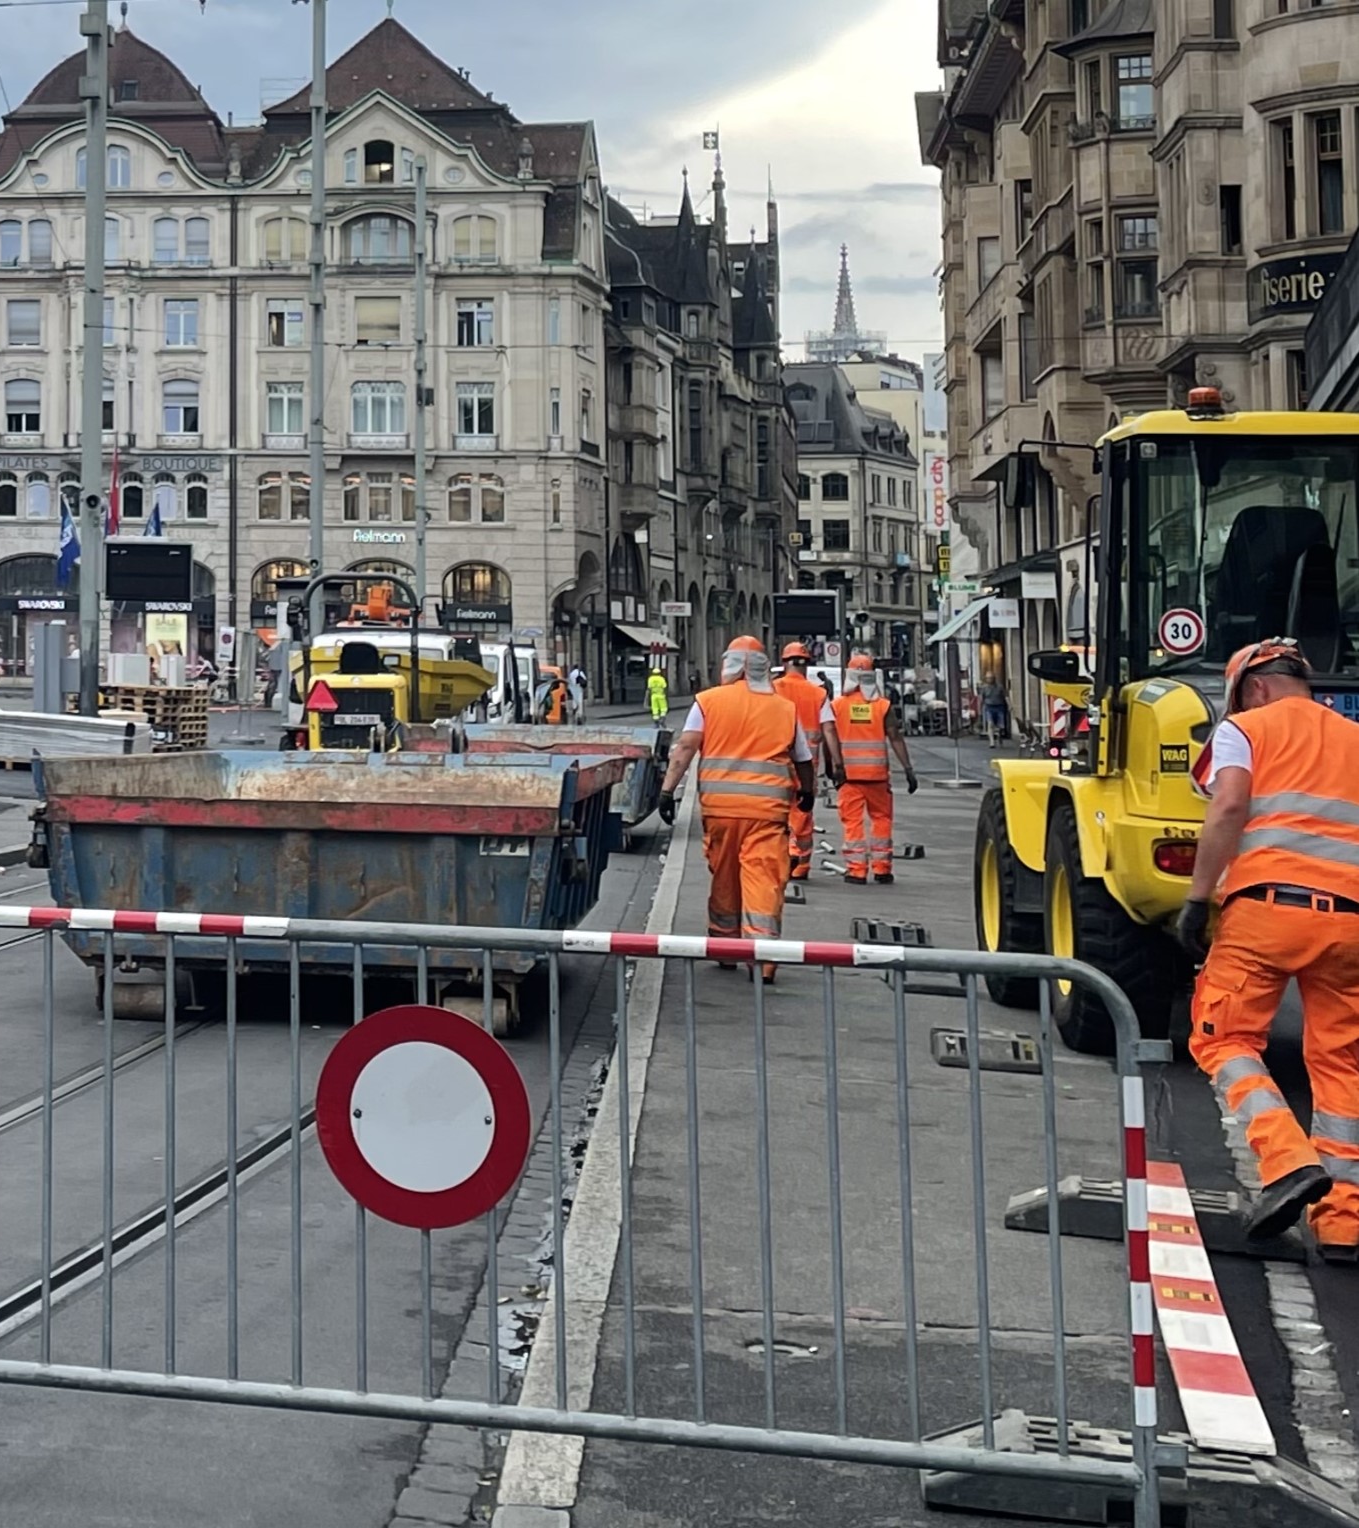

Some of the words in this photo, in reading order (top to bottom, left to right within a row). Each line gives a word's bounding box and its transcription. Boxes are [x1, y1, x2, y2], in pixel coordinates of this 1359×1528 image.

[1261, 261, 1325, 306] fiserie
[142, 457, 217, 471] BOUTIQUE
[353, 529, 406, 542] fielmann
[18, 600, 65, 610] SWAROVSKI
[145, 602, 192, 612] SWAROVSKI
[1170, 623, 1192, 640] 30
[1162, 749, 1187, 761] WAG
